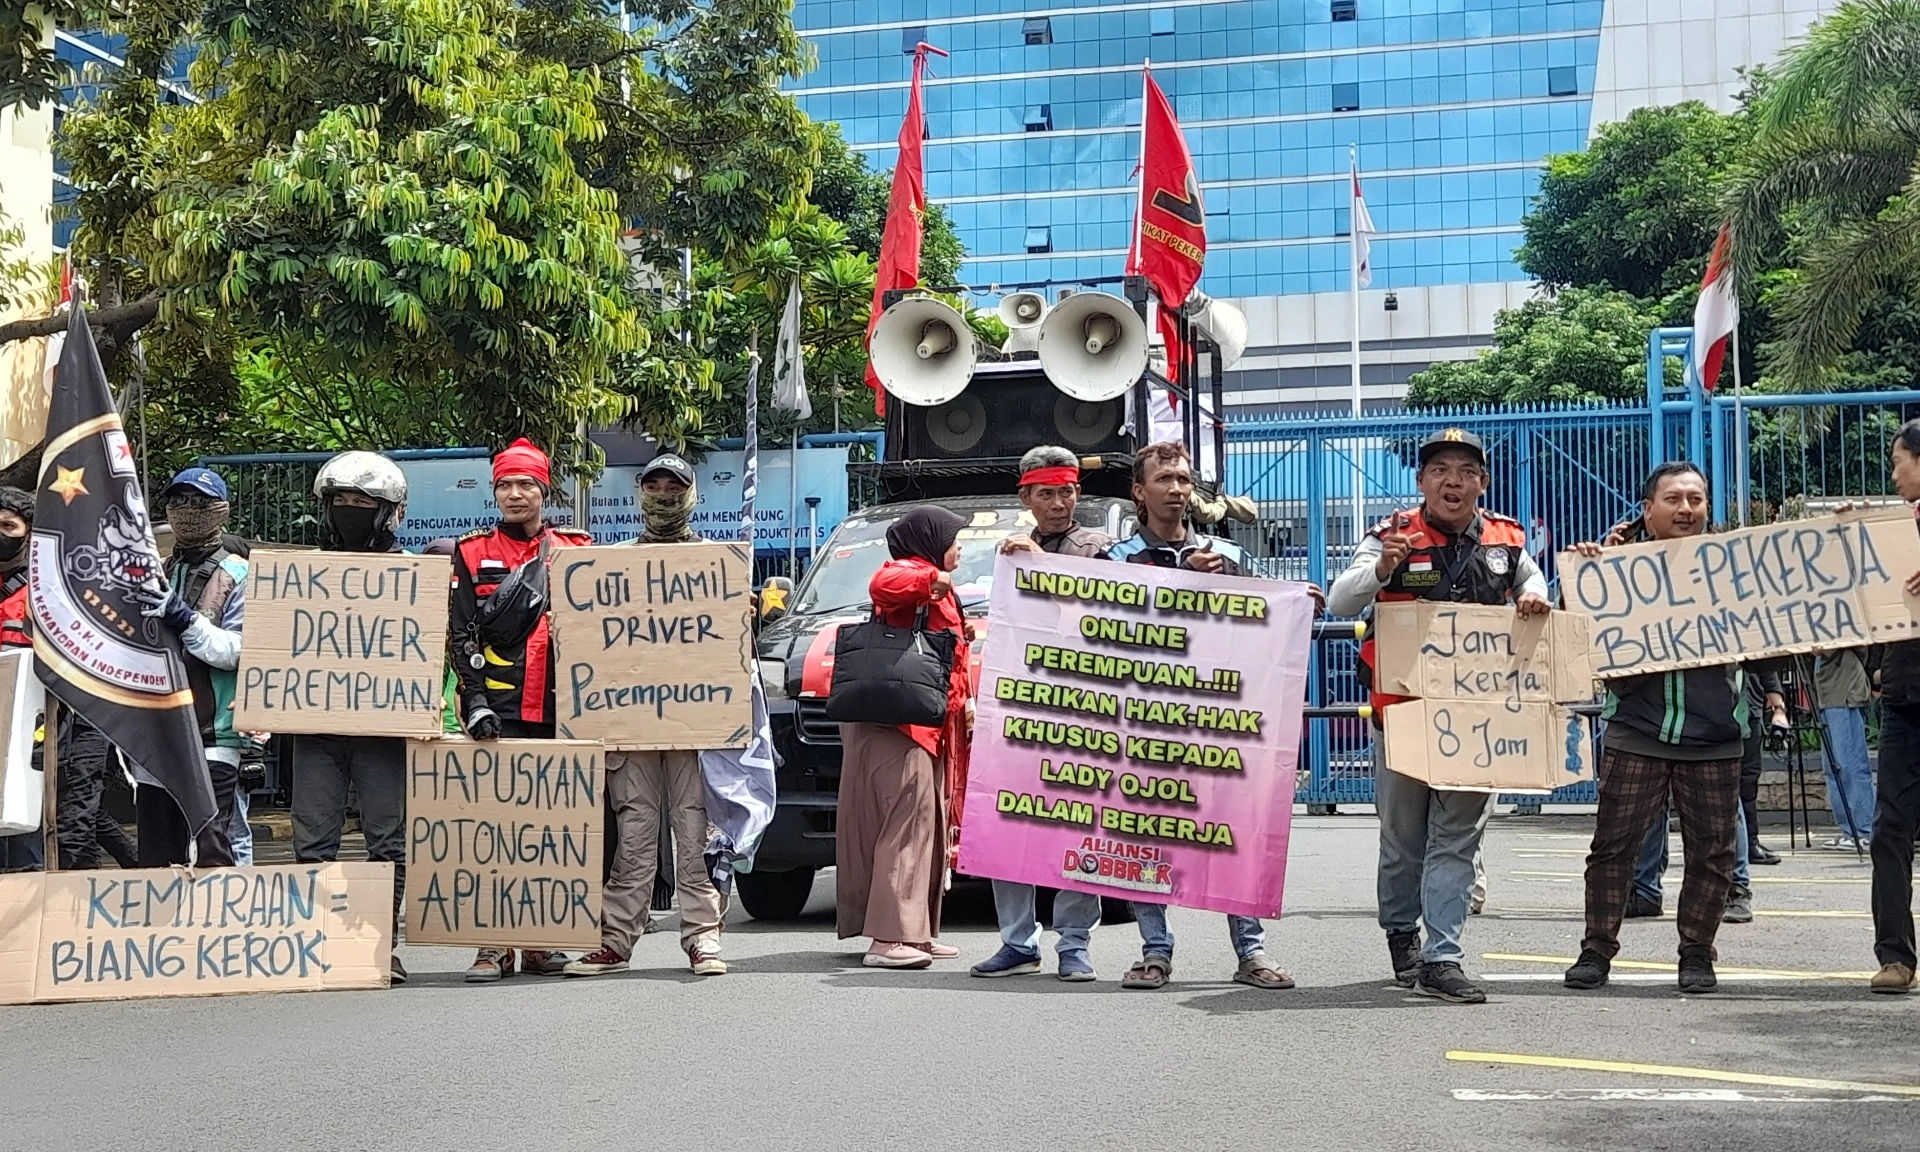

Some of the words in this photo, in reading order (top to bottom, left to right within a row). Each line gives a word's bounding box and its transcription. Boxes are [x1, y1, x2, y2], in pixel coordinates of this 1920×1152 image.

[1141, 220, 1170, 242] RIKAT
[407, 518, 471, 530] PENGUATAN
[688, 511, 709, 523] LAM
[712, 510, 784, 522] MENDKUNG
[253, 561, 330, 600] HAK
[1015, 567, 1147, 608] LINDUNGI
[1155, 586, 1268, 621] DRIVER
[1079, 615, 1188, 650] ONLINE
[1421, 611, 1516, 658] Jam
[91, 658, 167, 686] INDEPENDENT
[995, 676, 1119, 717] BERIKAN
[1124, 698, 1263, 735] HAK-HAK
[1003, 716, 1119, 755] KHUSUS
[1126, 736, 1243, 772] KEPADA
[1432, 708, 1461, 757] 8
[1472, 718, 1528, 768] Jam
[411, 748, 596, 810] HAPUSKAN
[1040, 759, 1113, 790] LADY
[1119, 774, 1197, 804] OJOL
[411, 816, 590, 867] POTONGAN
[996, 789, 1093, 826] DALAM
[1101, 807, 1235, 847] BEKERJA
[1079, 836, 1160, 861] ALIANSI
